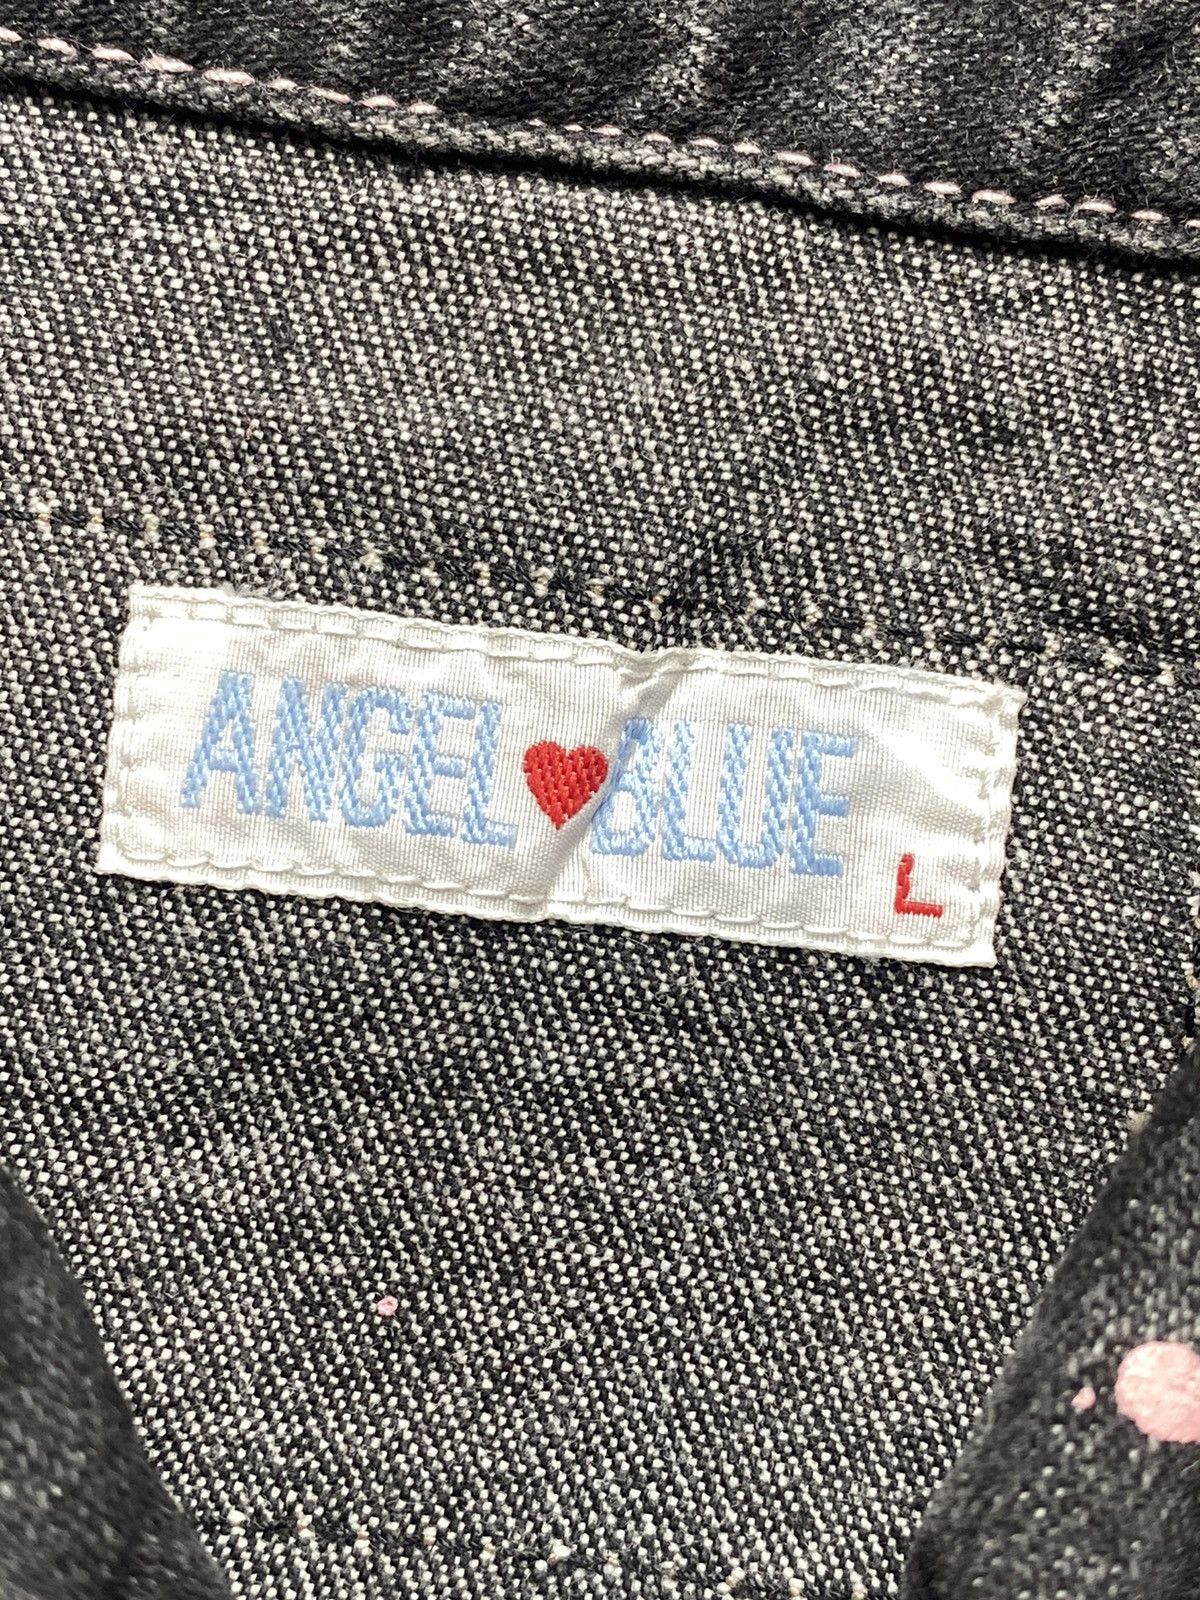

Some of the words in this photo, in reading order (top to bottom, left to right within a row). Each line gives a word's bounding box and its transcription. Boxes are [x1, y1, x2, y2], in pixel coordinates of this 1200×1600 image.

[180, 669, 517, 847] ANGEL
[589, 717, 855, 877] BLUE
[894, 852, 944, 918] L
